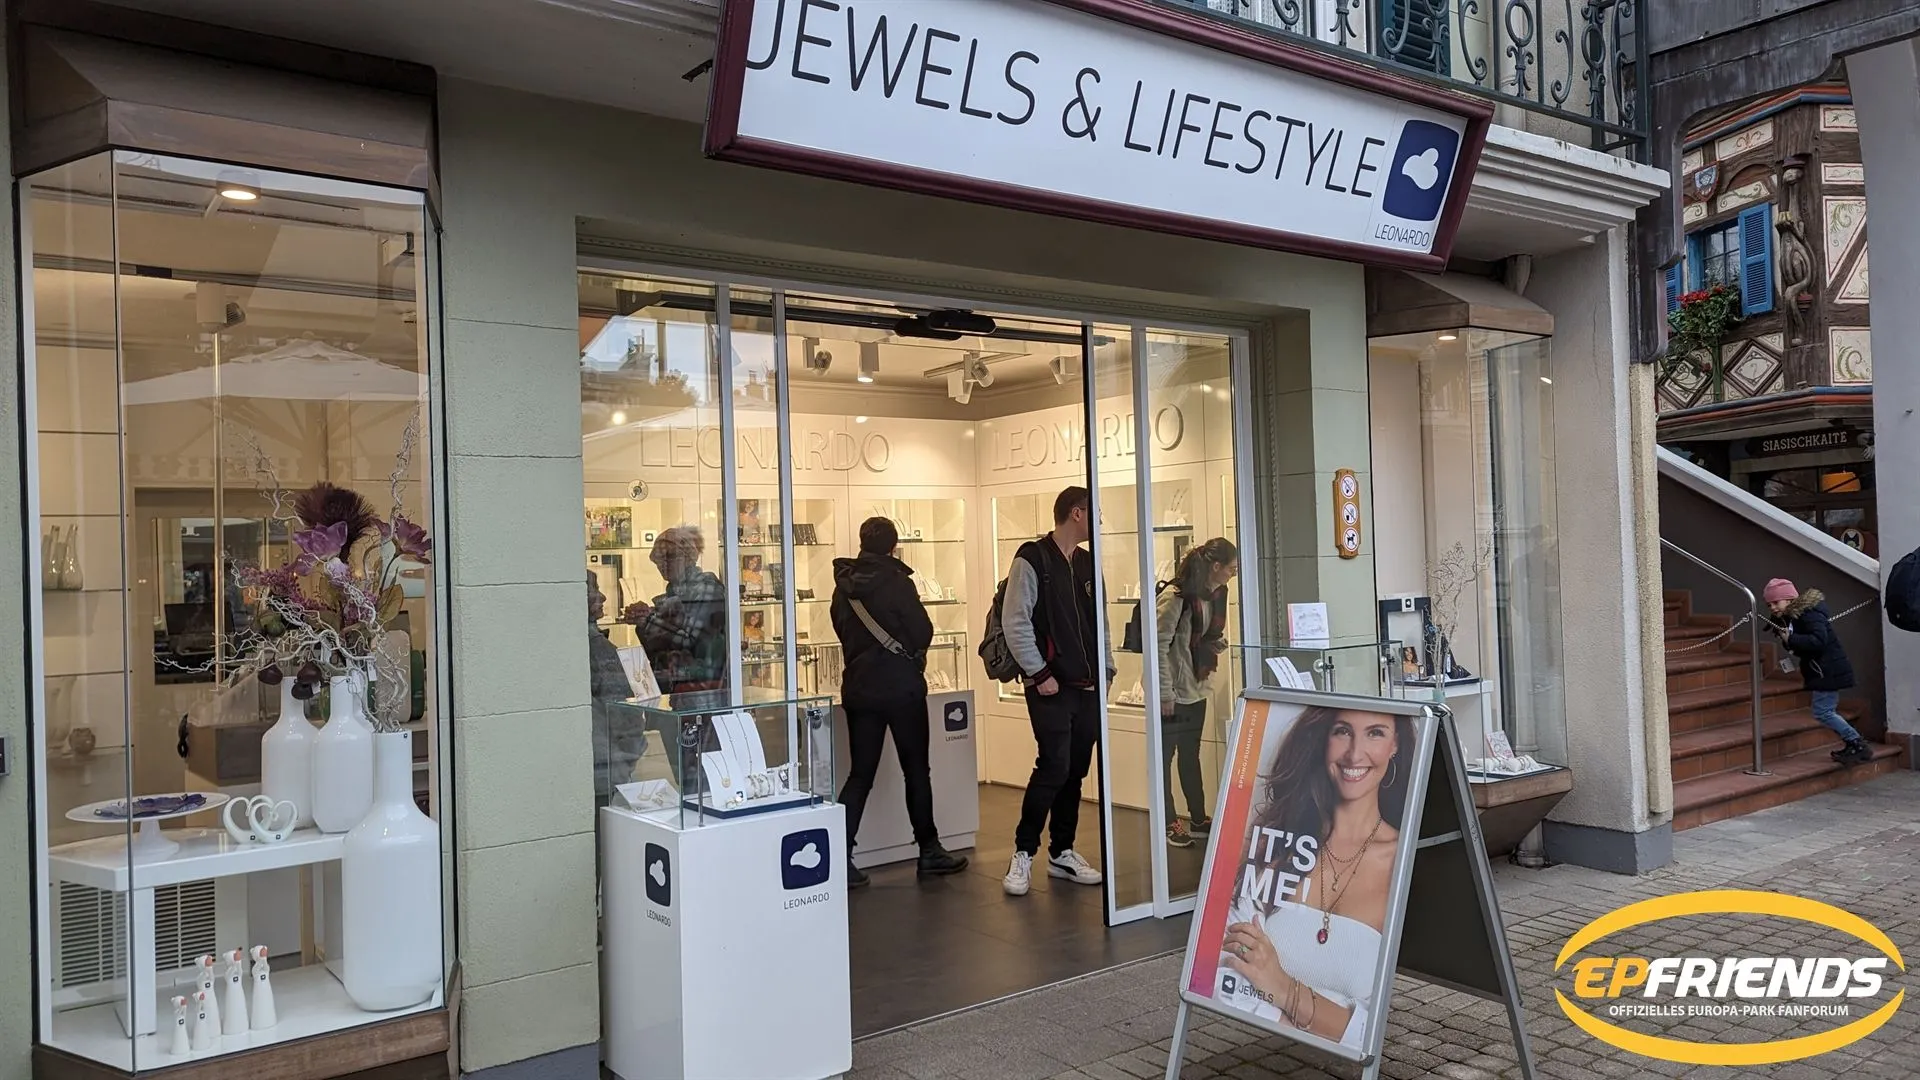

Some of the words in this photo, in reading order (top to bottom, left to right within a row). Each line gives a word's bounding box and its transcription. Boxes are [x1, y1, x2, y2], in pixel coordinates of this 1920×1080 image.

[746, 0, 1040, 125] JEWELS
[1062, 68, 1101, 142] &
[1124, 80, 1386, 199] LIFESTYLE
[1374, 223, 1430, 247] LEONARDO
[1762, 431, 1848, 452] SIASISCHKAITE
[1240, 863, 1312, 908] ME!
[782, 892, 831, 910] LEONARDO
[646, 909, 672, 928] LEONARDO
[1238, 984, 1274, 1004] JEWELS
